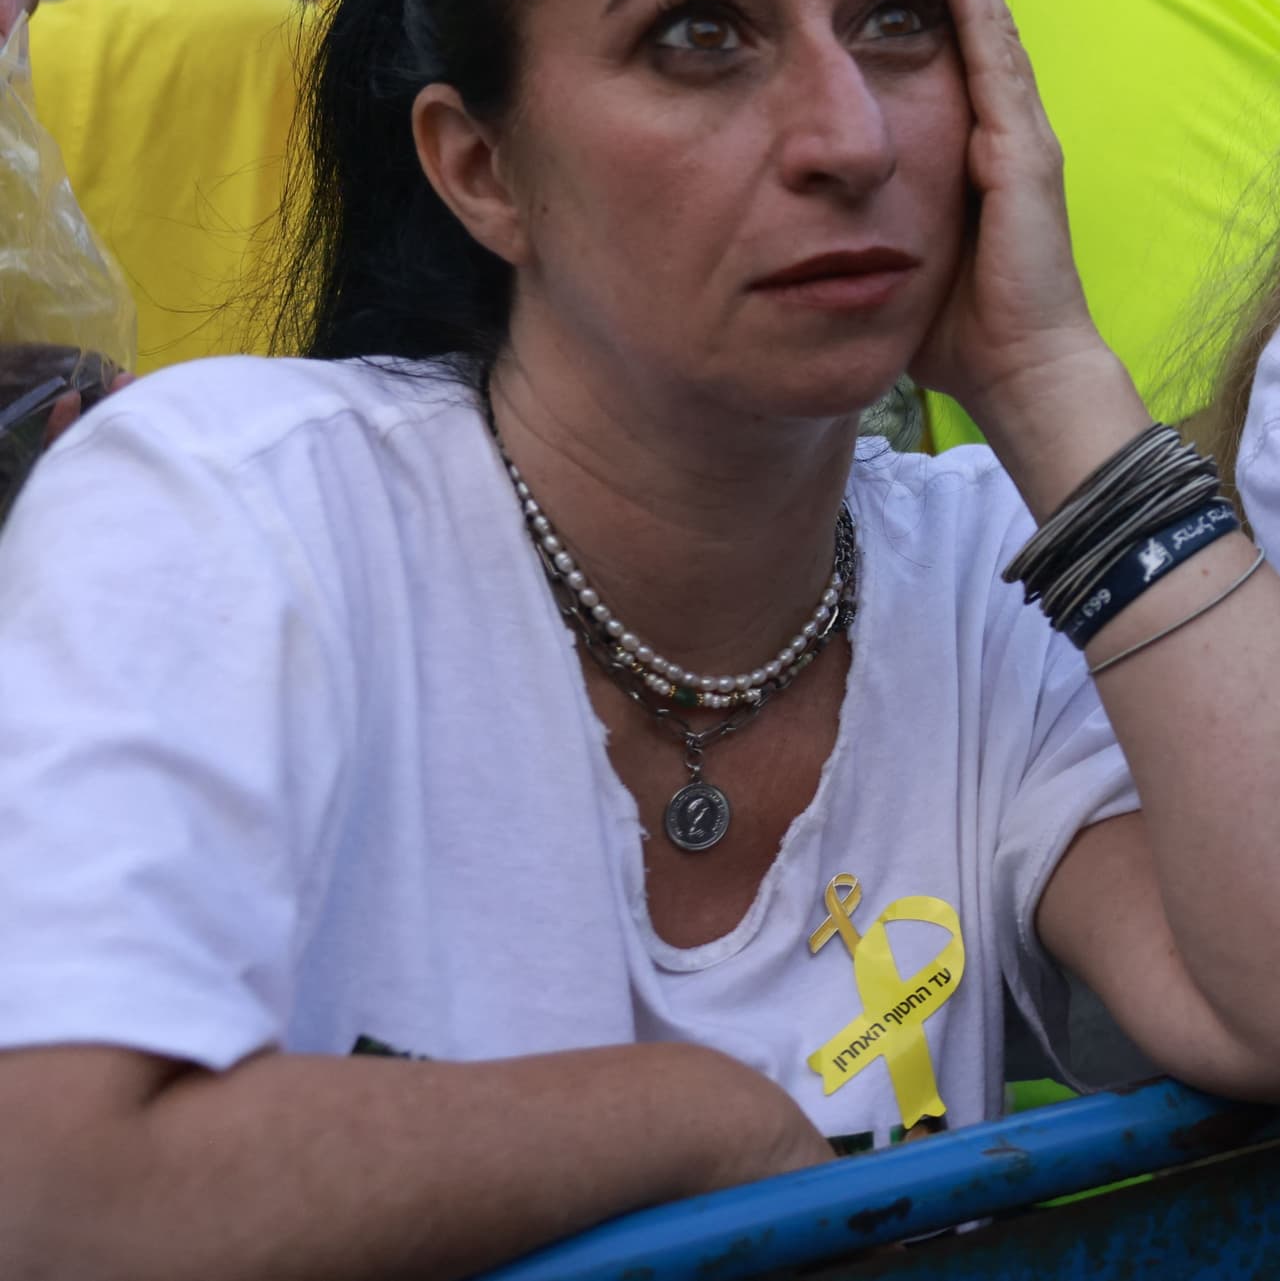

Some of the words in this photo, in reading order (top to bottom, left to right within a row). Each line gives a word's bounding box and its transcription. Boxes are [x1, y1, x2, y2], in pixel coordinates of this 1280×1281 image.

[928, 967, 952, 987] עד
[884, 985, 933, 1026] החטוף
[832, 1021, 888, 1073] האחרון
